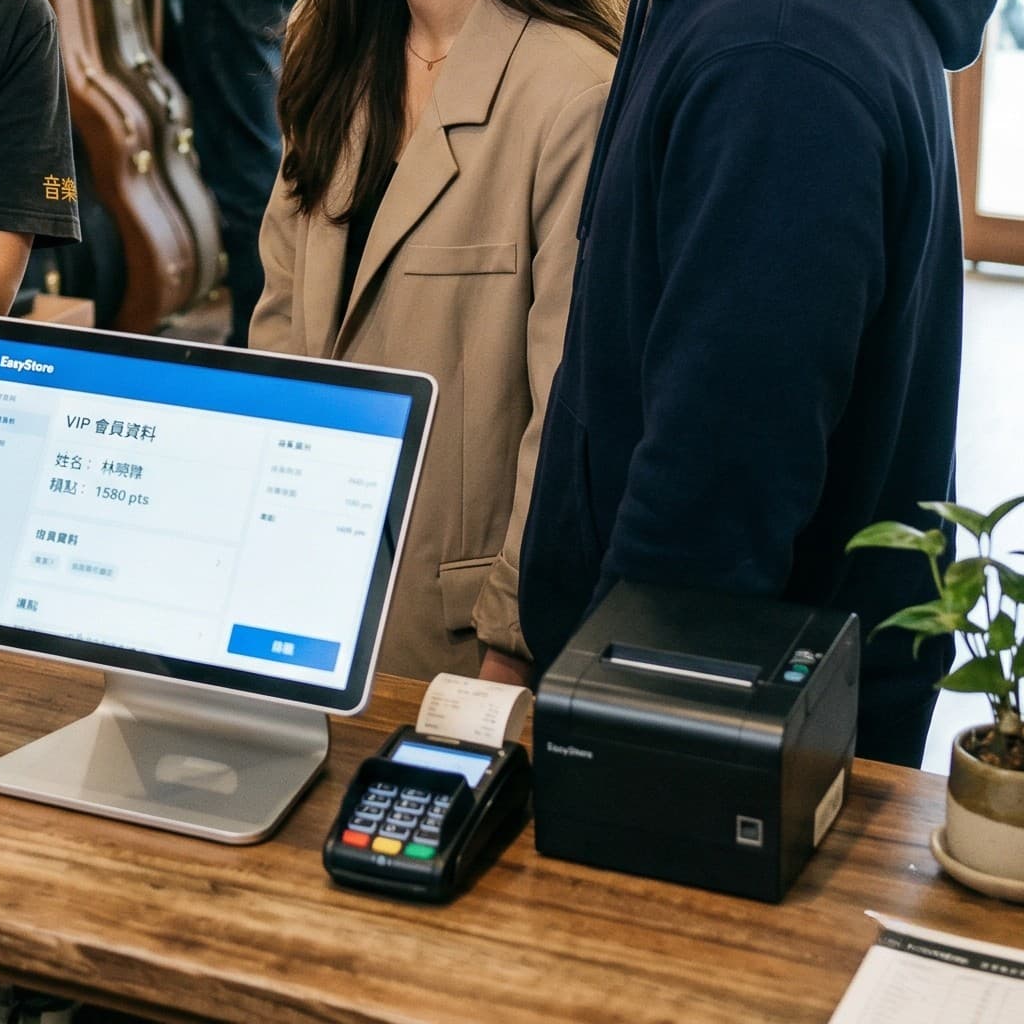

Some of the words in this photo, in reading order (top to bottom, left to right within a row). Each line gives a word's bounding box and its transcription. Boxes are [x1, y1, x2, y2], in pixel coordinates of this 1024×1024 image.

[42, 174, 78, 202] 音樂
[0, 355, 55, 373] EasyStore
[66, 415, 91, 430] VIP
[95, 418, 156, 443] 會員資料
[96, 486, 127, 502] 1580
[128, 494, 150, 506] pts
